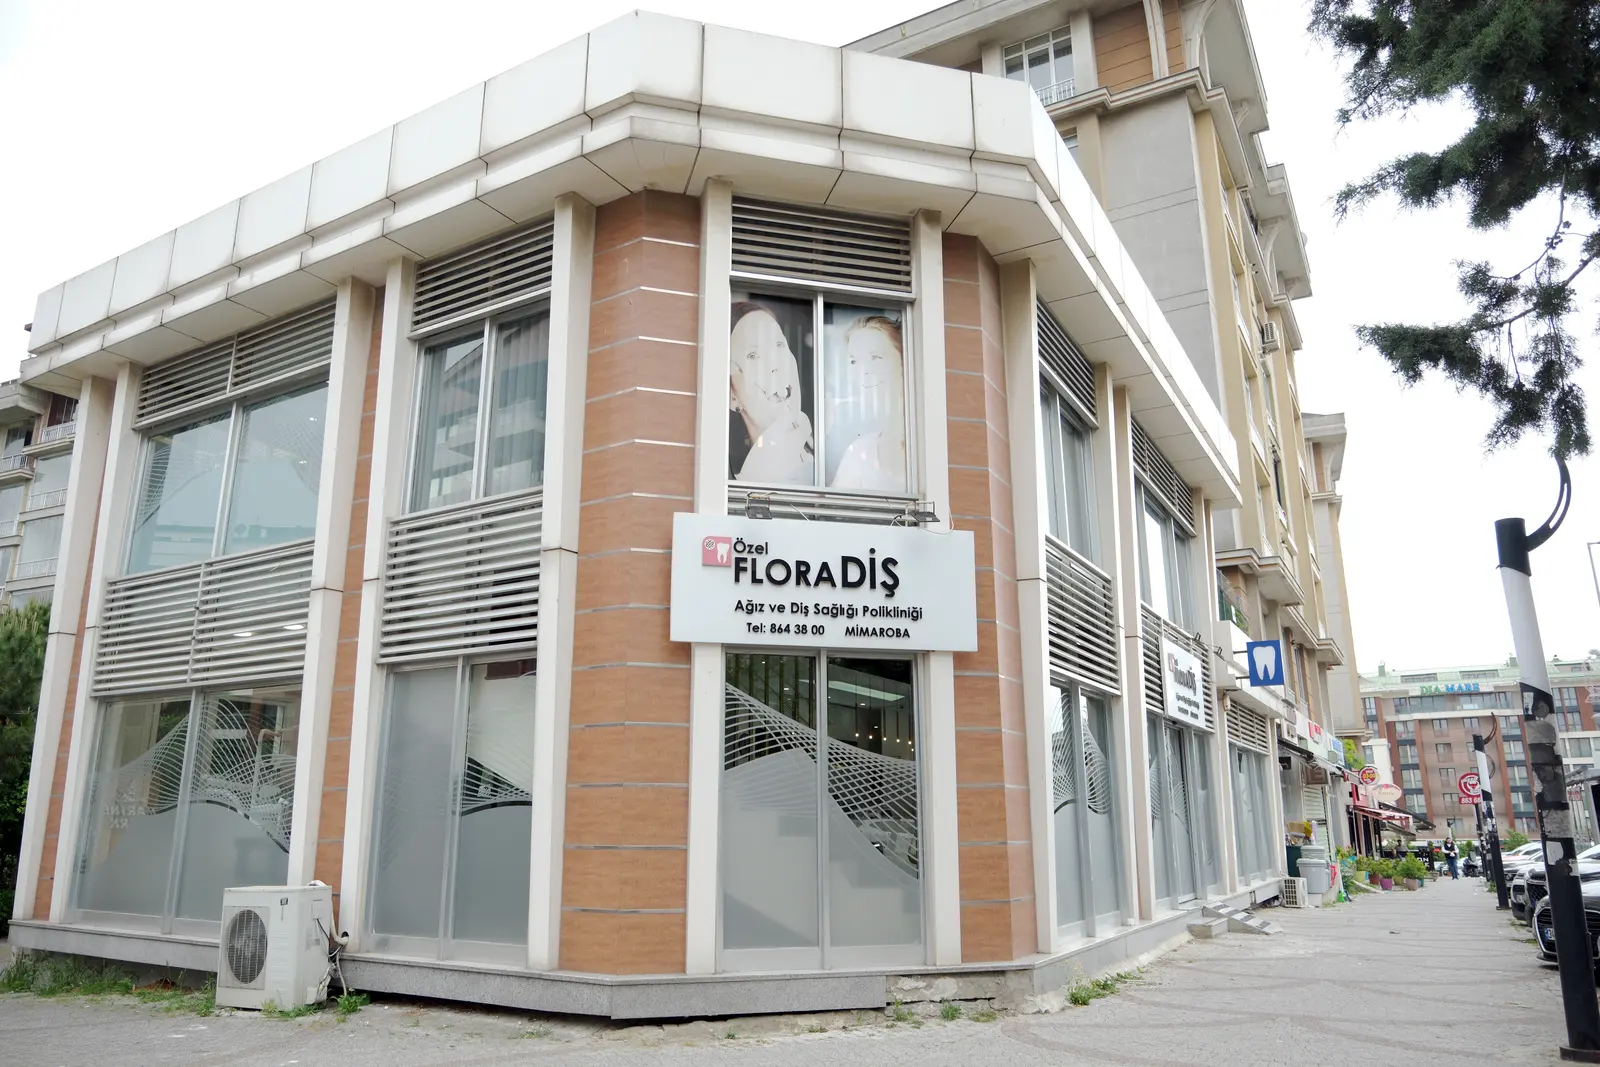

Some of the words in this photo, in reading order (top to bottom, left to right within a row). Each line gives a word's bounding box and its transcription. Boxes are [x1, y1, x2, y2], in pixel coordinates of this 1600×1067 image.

[733, 537, 768, 555] Özel
[733, 547, 900, 598] FLORADİŞ
[734, 599, 765, 614] Ağız
[769, 604, 786, 614] ve
[790, 602, 809, 617] Diş
[813, 603, 858, 619] Sağlığı
[862, 605, 923, 621] Polikliniği
[746, 622, 767, 634] Tel:
[770, 623, 791, 635] 864
[794, 625, 808, 635] 38
[811, 625, 825, 636] 00
[845, 624, 911, 639] MİMAROBA
